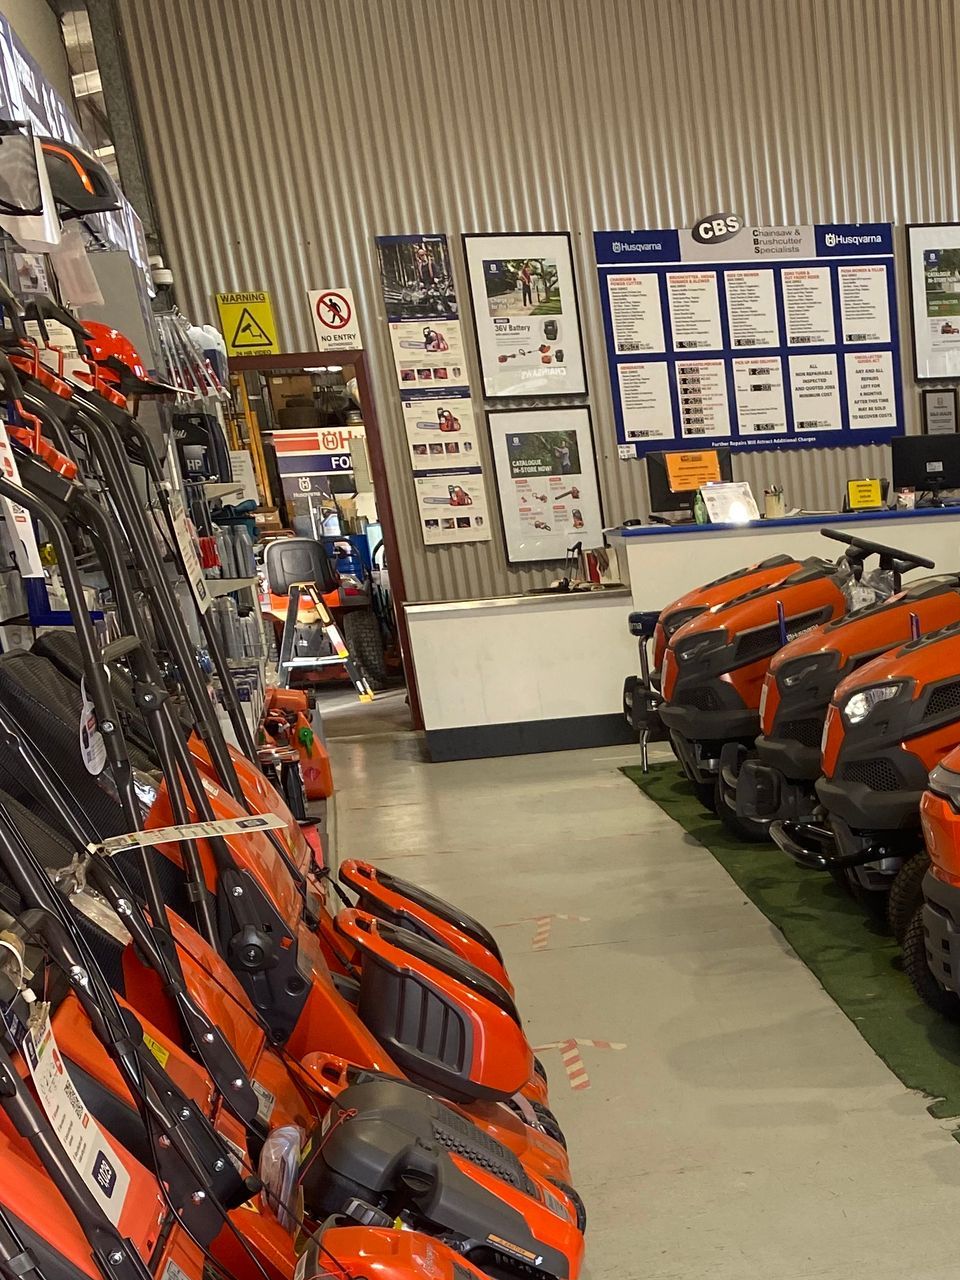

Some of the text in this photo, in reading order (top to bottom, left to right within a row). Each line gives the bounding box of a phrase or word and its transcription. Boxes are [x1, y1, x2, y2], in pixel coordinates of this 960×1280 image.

[699, 216, 740, 240] CBS
[753, 229, 792, 237] Chainsaw
[753, 237, 802, 246] Brushcutter
[835, 234, 882, 245] Husqvarna
[621, 242, 662, 252] Husqvarna
[754, 245, 800, 254] Specialists
[220, 293, 266, 303] WARNING
[494, 324, 531, 333] 36V Battery
[187, 460, 203, 471] HP
[331, 457, 353, 469] FO
